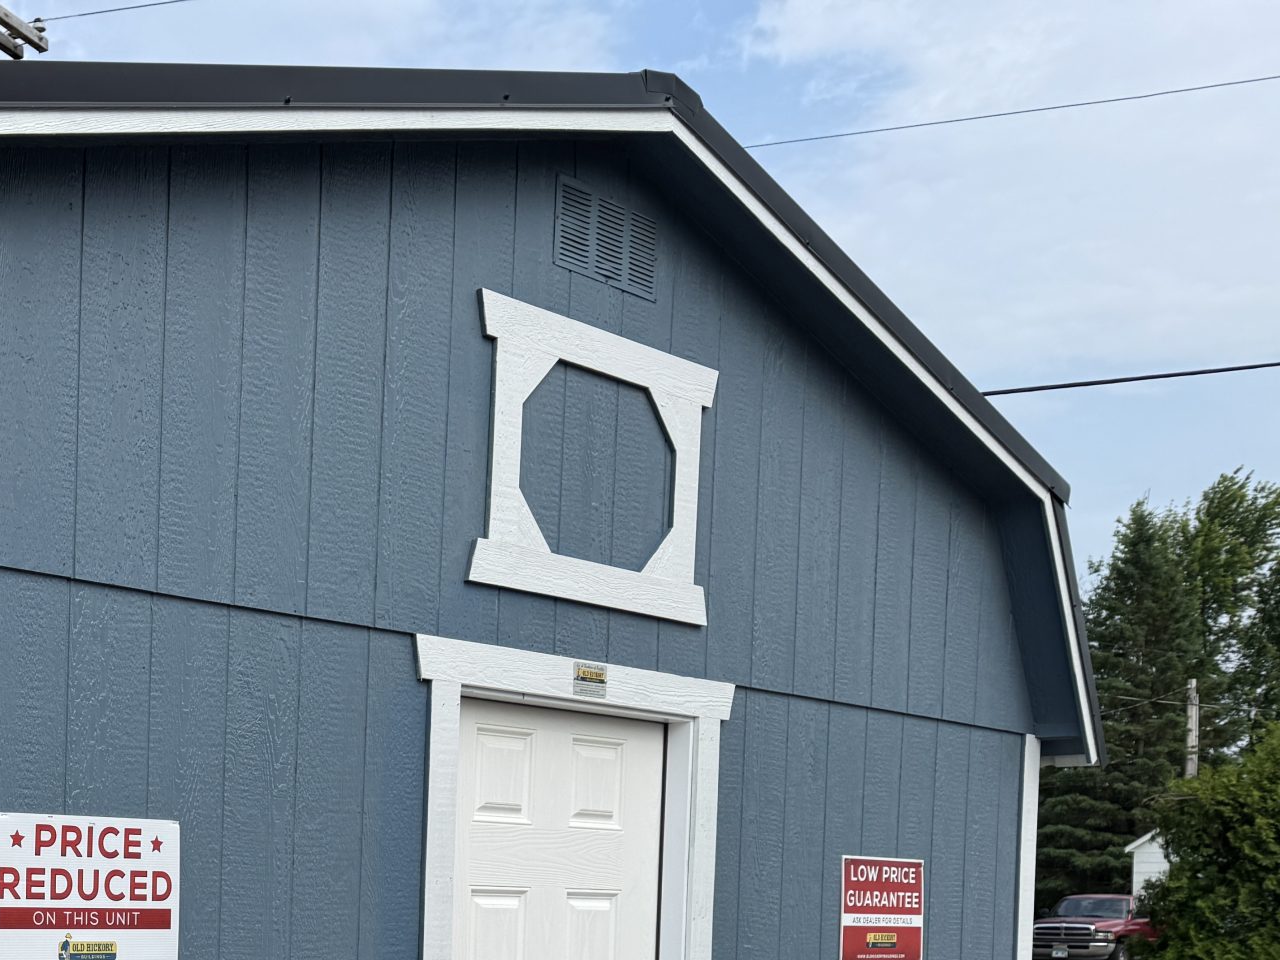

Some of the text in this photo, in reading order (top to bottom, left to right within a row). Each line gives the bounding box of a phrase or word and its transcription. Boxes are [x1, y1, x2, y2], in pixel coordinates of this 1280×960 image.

[34, 824, 142, 859] PRICE
[850, 864, 916, 884] LOW PRICE
[846, 890, 920, 908] GUARANTEE
[32, 910, 141, 926] ON THIS UNIT
[852, 916, 862, 924] ASK
[862, 916, 880, 924] DEALER
[72, 943, 114, 952] OLD HICKORY
